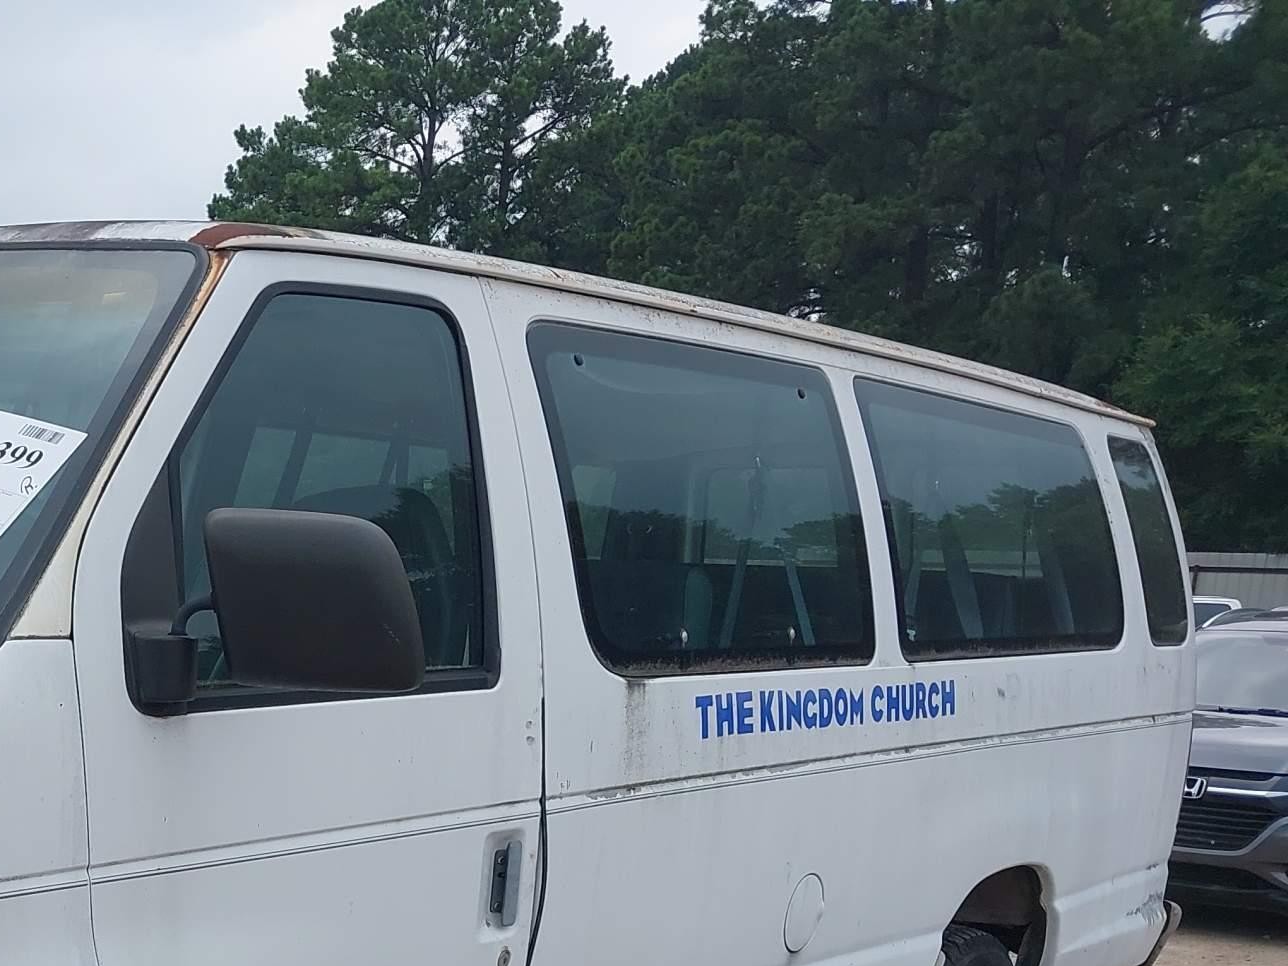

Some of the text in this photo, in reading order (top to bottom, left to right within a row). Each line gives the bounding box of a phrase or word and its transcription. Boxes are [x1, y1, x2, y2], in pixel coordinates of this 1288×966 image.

[695, 680, 956, 739] THE KINGDOM CHURCH
